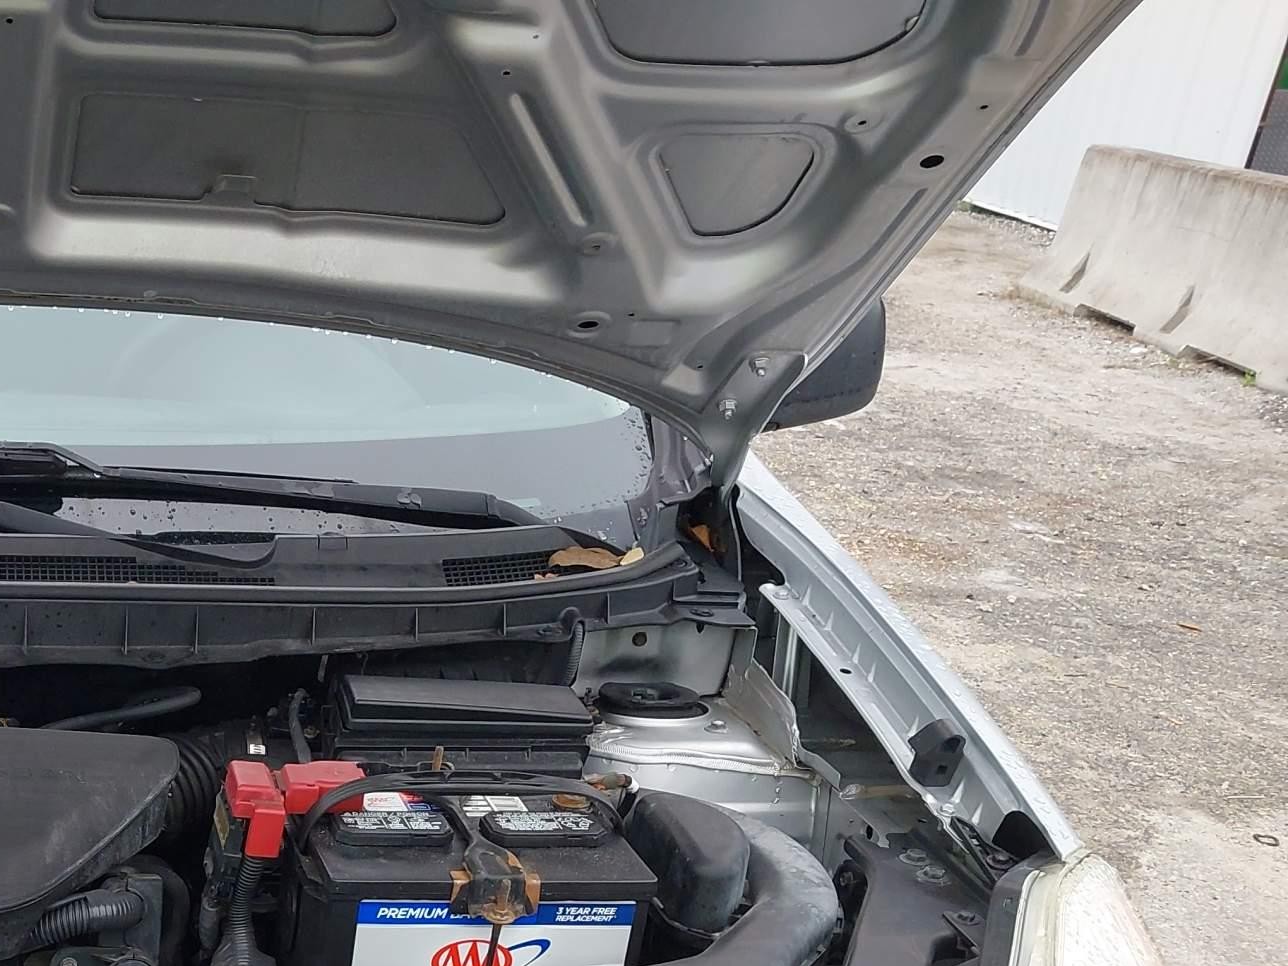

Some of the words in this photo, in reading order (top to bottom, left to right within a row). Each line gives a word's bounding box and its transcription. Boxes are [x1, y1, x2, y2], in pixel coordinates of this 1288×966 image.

[376, 907, 449, 919] PREMIUM
[565, 907, 591, 915] YEAR
[591, 907, 618, 915] FREE
